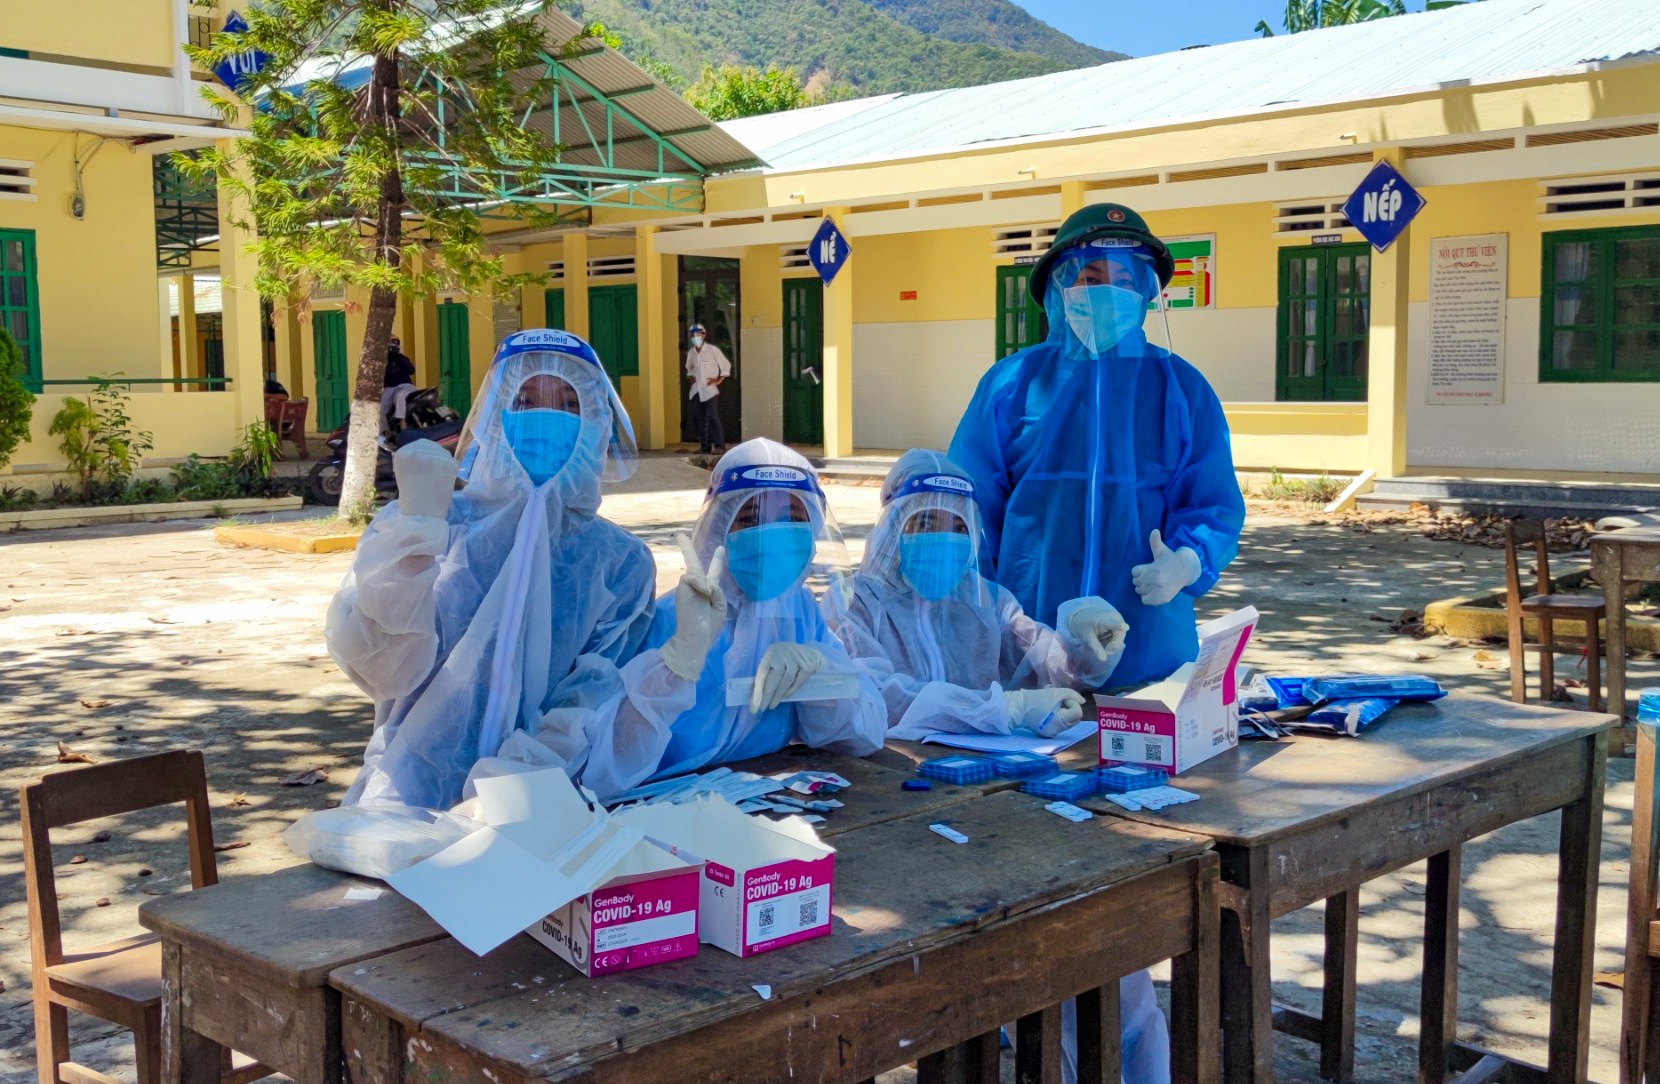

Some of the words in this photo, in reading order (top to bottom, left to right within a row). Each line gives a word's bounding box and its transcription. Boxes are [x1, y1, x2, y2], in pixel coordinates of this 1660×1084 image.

[1362, 178, 1402, 223] NẾP
[1101, 238, 1116, 246] Face
[1117, 237, 1135, 247] Shield
[523, 335, 541, 344] Face
[543, 333, 568, 345] Shield
[755, 469, 773, 478] Face
[775, 469, 797, 479] Shield
[934, 478, 950, 486] Face
[951, 478, 968, 490] Shield
[1100, 711, 1128, 720] GenBody
[1100, 718, 1141, 731] COVID-19
[1143, 722, 1156, 734] Ag
[747, 872, 781, 886] GenBody
[747, 878, 796, 900] COVID-19
[799, 875, 812, 889] Ag
[594, 893, 635, 908] GenBody
[593, 901, 653, 924] COVID-19
[655, 899, 672, 913] Ag
[542, 920, 572, 950] COVID-19
